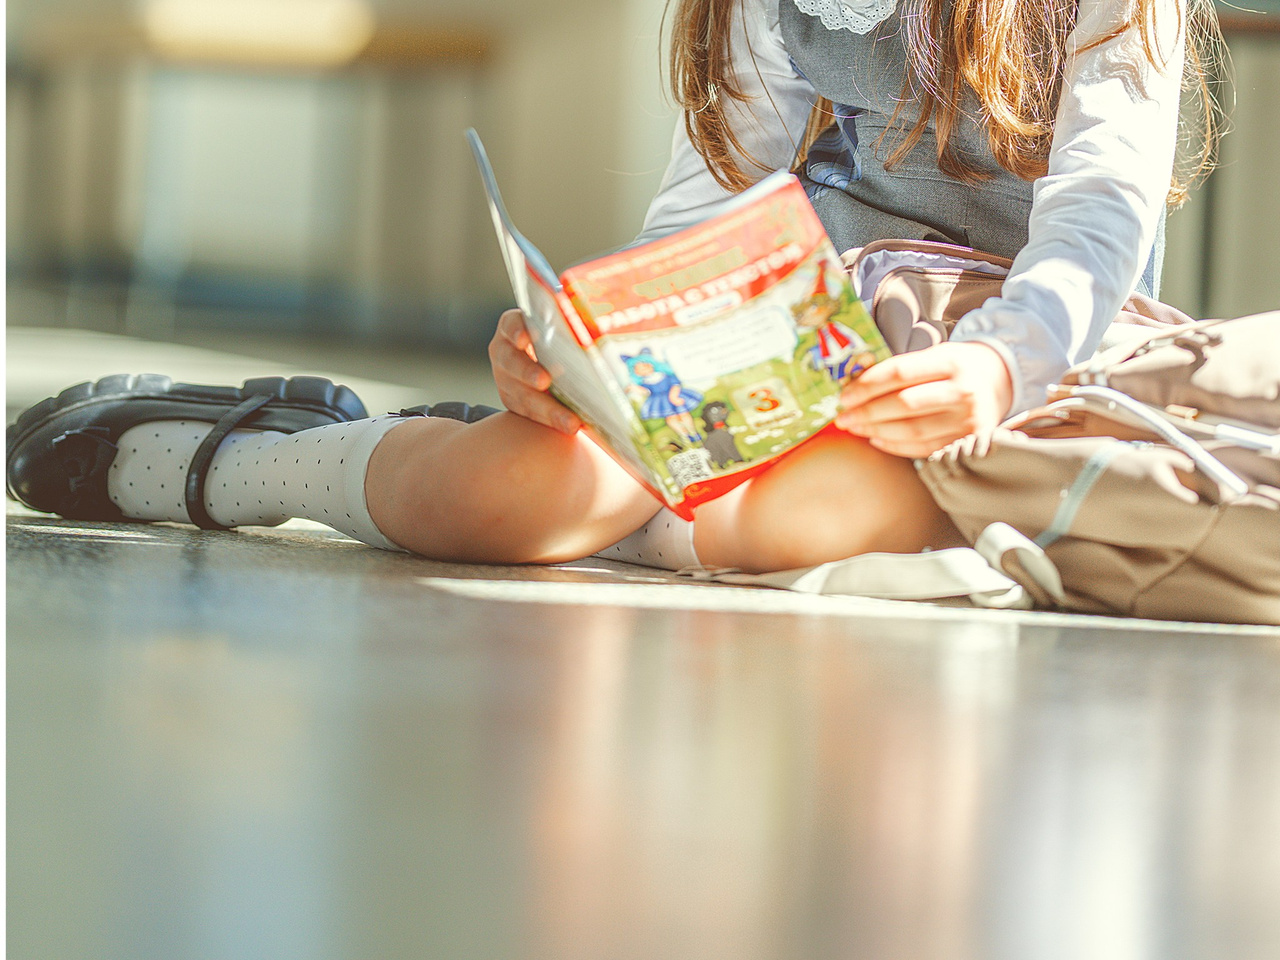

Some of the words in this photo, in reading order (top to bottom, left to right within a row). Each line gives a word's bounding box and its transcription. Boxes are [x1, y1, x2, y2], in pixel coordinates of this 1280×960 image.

[595, 293, 685, 332] РАБОТА
[683, 287, 704, 305] С
[701, 242, 804, 296] ТЕКСТОМ
[749, 388, 780, 412] 3
